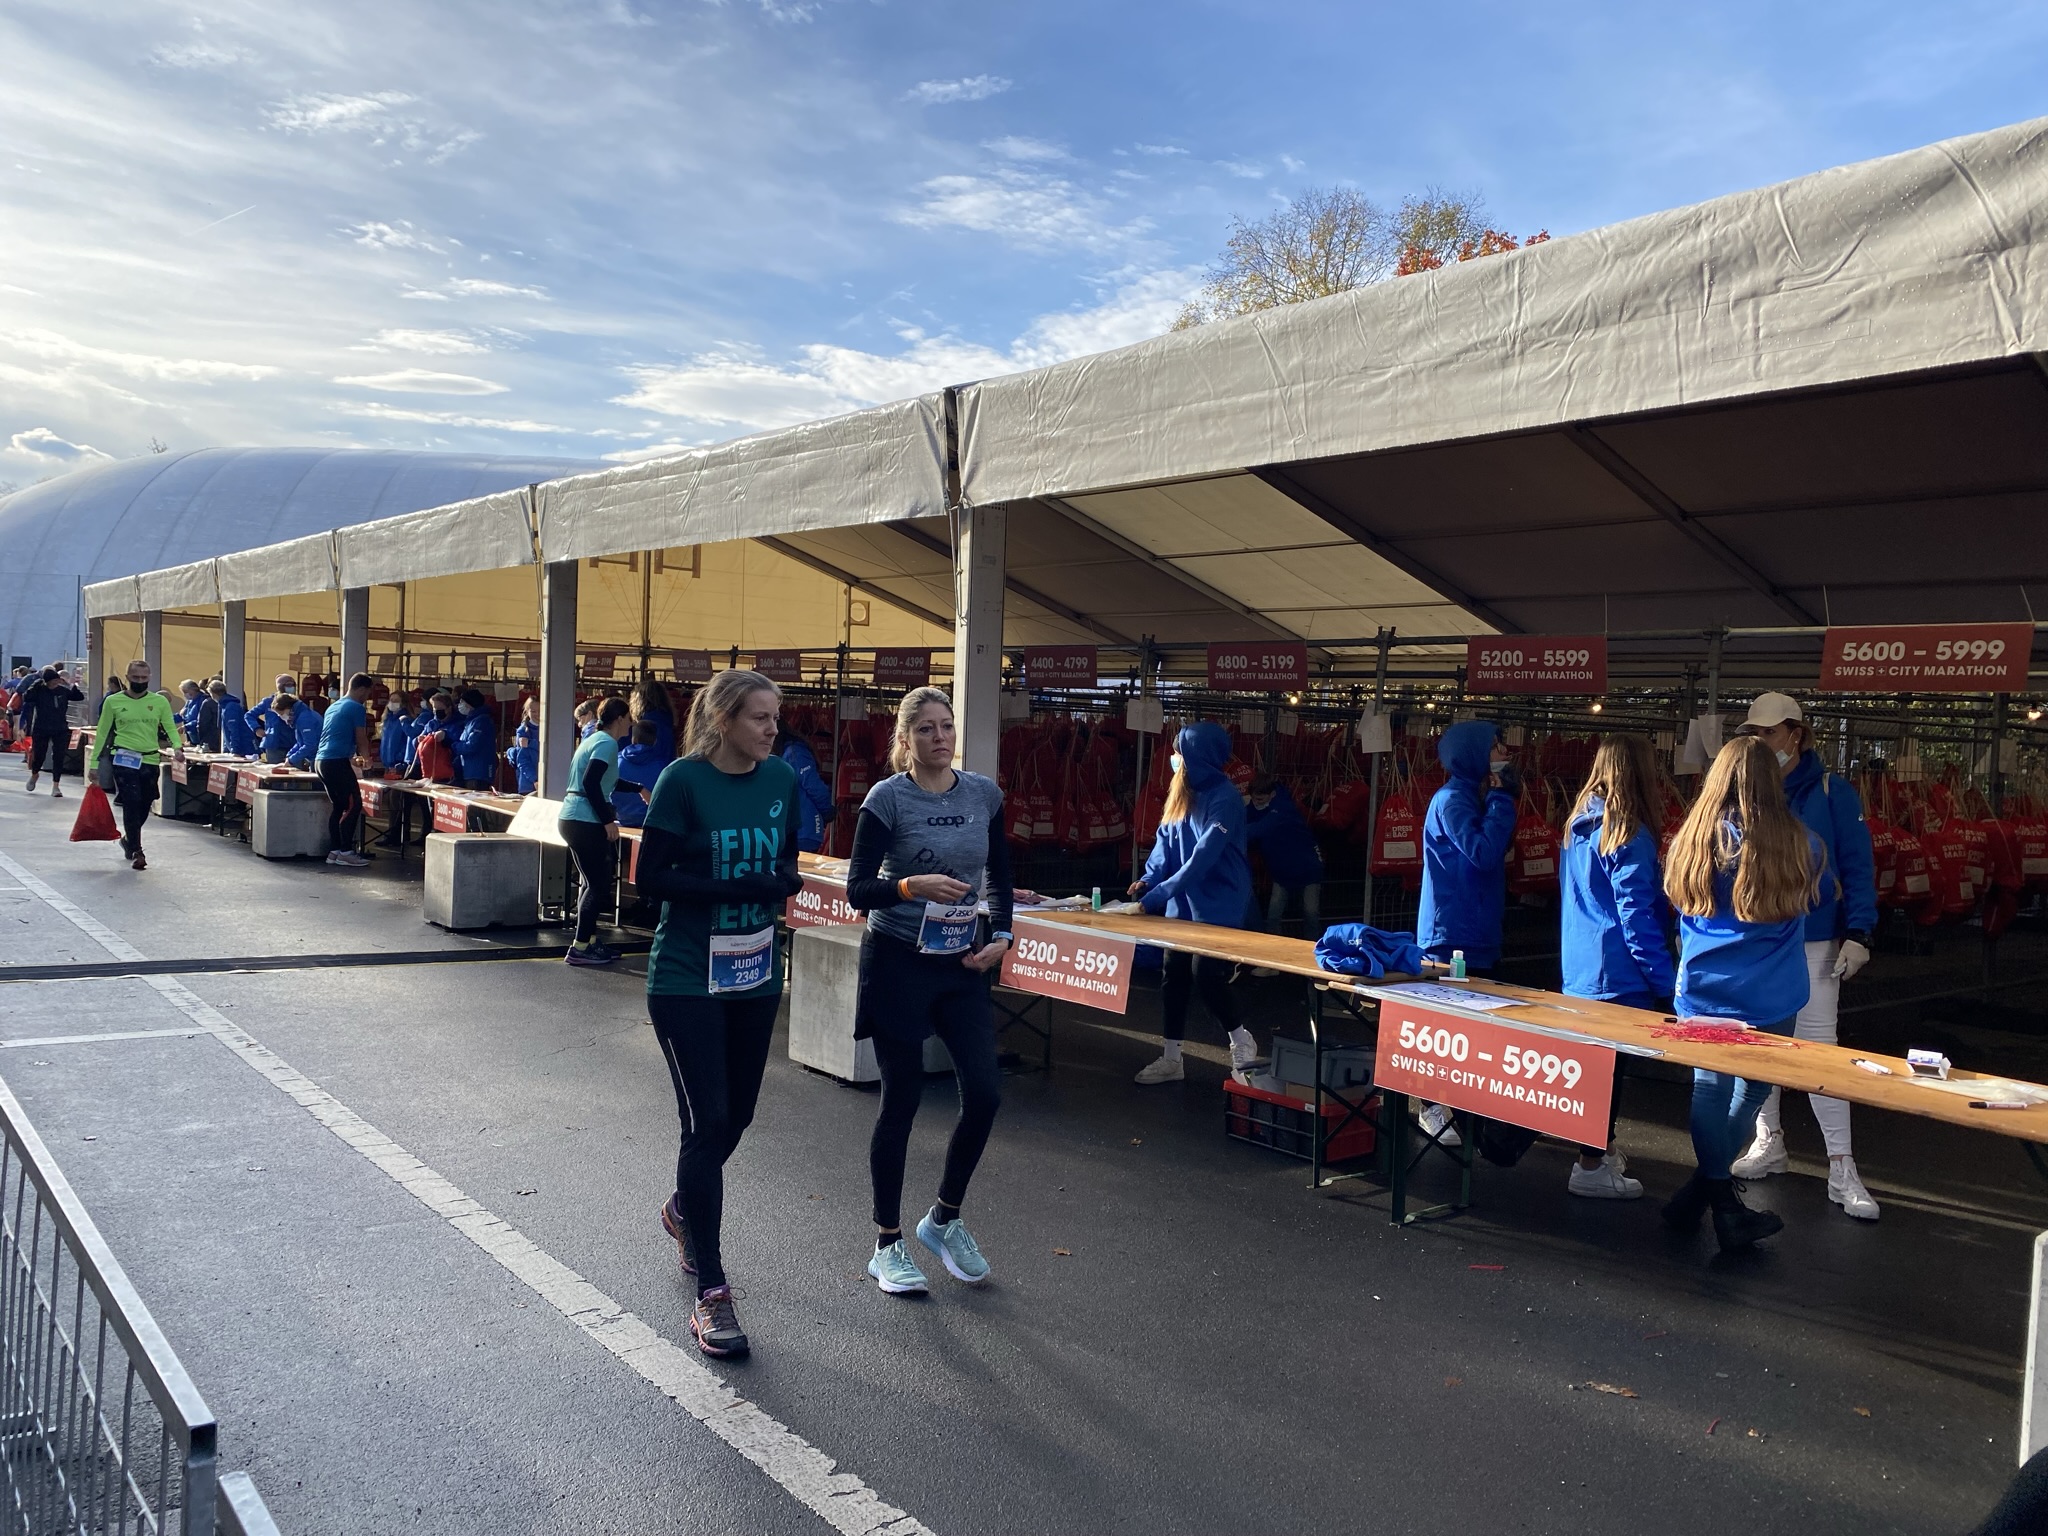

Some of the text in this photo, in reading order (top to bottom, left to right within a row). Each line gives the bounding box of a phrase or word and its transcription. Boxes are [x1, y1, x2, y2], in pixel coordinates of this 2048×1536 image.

[1480, 650, 1523, 667] 5200
[1543, 649, 1590, 667] 5599
[1841, 641, 1906, 661] 5600
[1935, 639, 2006, 661] 5999
[879, 656, 898, 668] 4000
[904, 656, 925, 668] 4399
[1030, 657, 1054, 669] 4400
[1063, 656, 1089, 669] 4799
[1216, 655, 1248, 669] 4800
[1261, 655, 1295, 669] 5199
[1834, 665, 2007, 676] SWISS CITY MARATHON
[1257, 672, 1298, 680] MARATHON
[1477, 670, 1593, 680] SWISS CITY MARATHON
[927, 815, 965, 828] coop
[720, 827, 779, 862] FIN
[711, 830, 720, 880] WITZERLAND
[795, 889, 821, 911] 4800
[792, 908, 809, 921] SWISS
[813, 915, 827, 926] CITY
[941, 925, 969, 936] SONJA
[944, 937, 961, 948] 426
[731, 953, 763, 970] JUDITH
[1017, 937, 1058, 965] 5200
[1074, 948, 1119, 977] 5599
[735, 967, 760, 984] 2349
[1011, 962, 1118, 996] SWISS CITY MARATHON
[1398, 1020, 1469, 1062] 5600
[1501, 1044, 1583, 1090] 5999
[1390, 1053, 1585, 1117] SWISS CITY MARATHON
